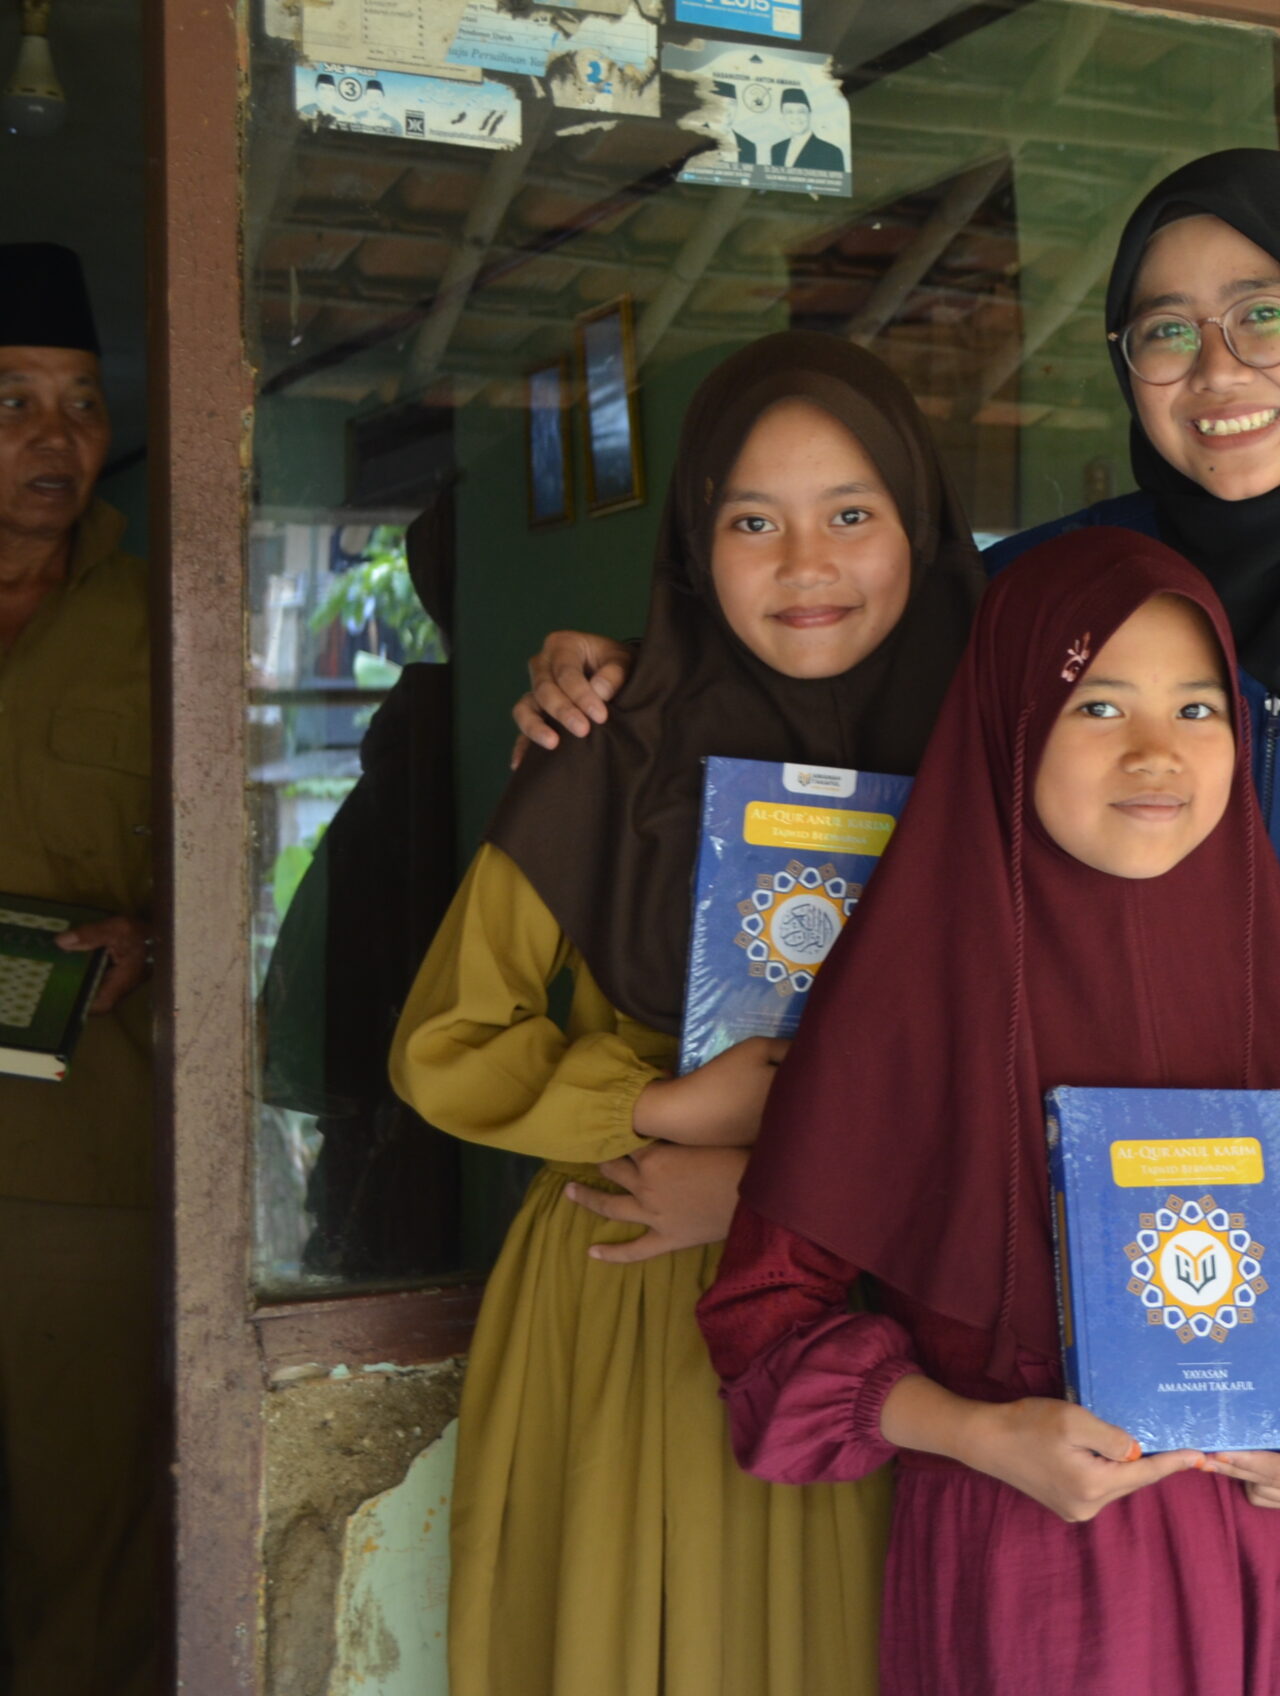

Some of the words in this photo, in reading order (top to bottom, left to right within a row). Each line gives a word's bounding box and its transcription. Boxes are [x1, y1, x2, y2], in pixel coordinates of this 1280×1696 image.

[344, 81, 357, 98] 3
[1182, 1369, 1228, 1379] YAYASAN
[1158, 1382, 1207, 1392] AMANAH
[1209, 1380, 1256, 1391] TAKAFUL
